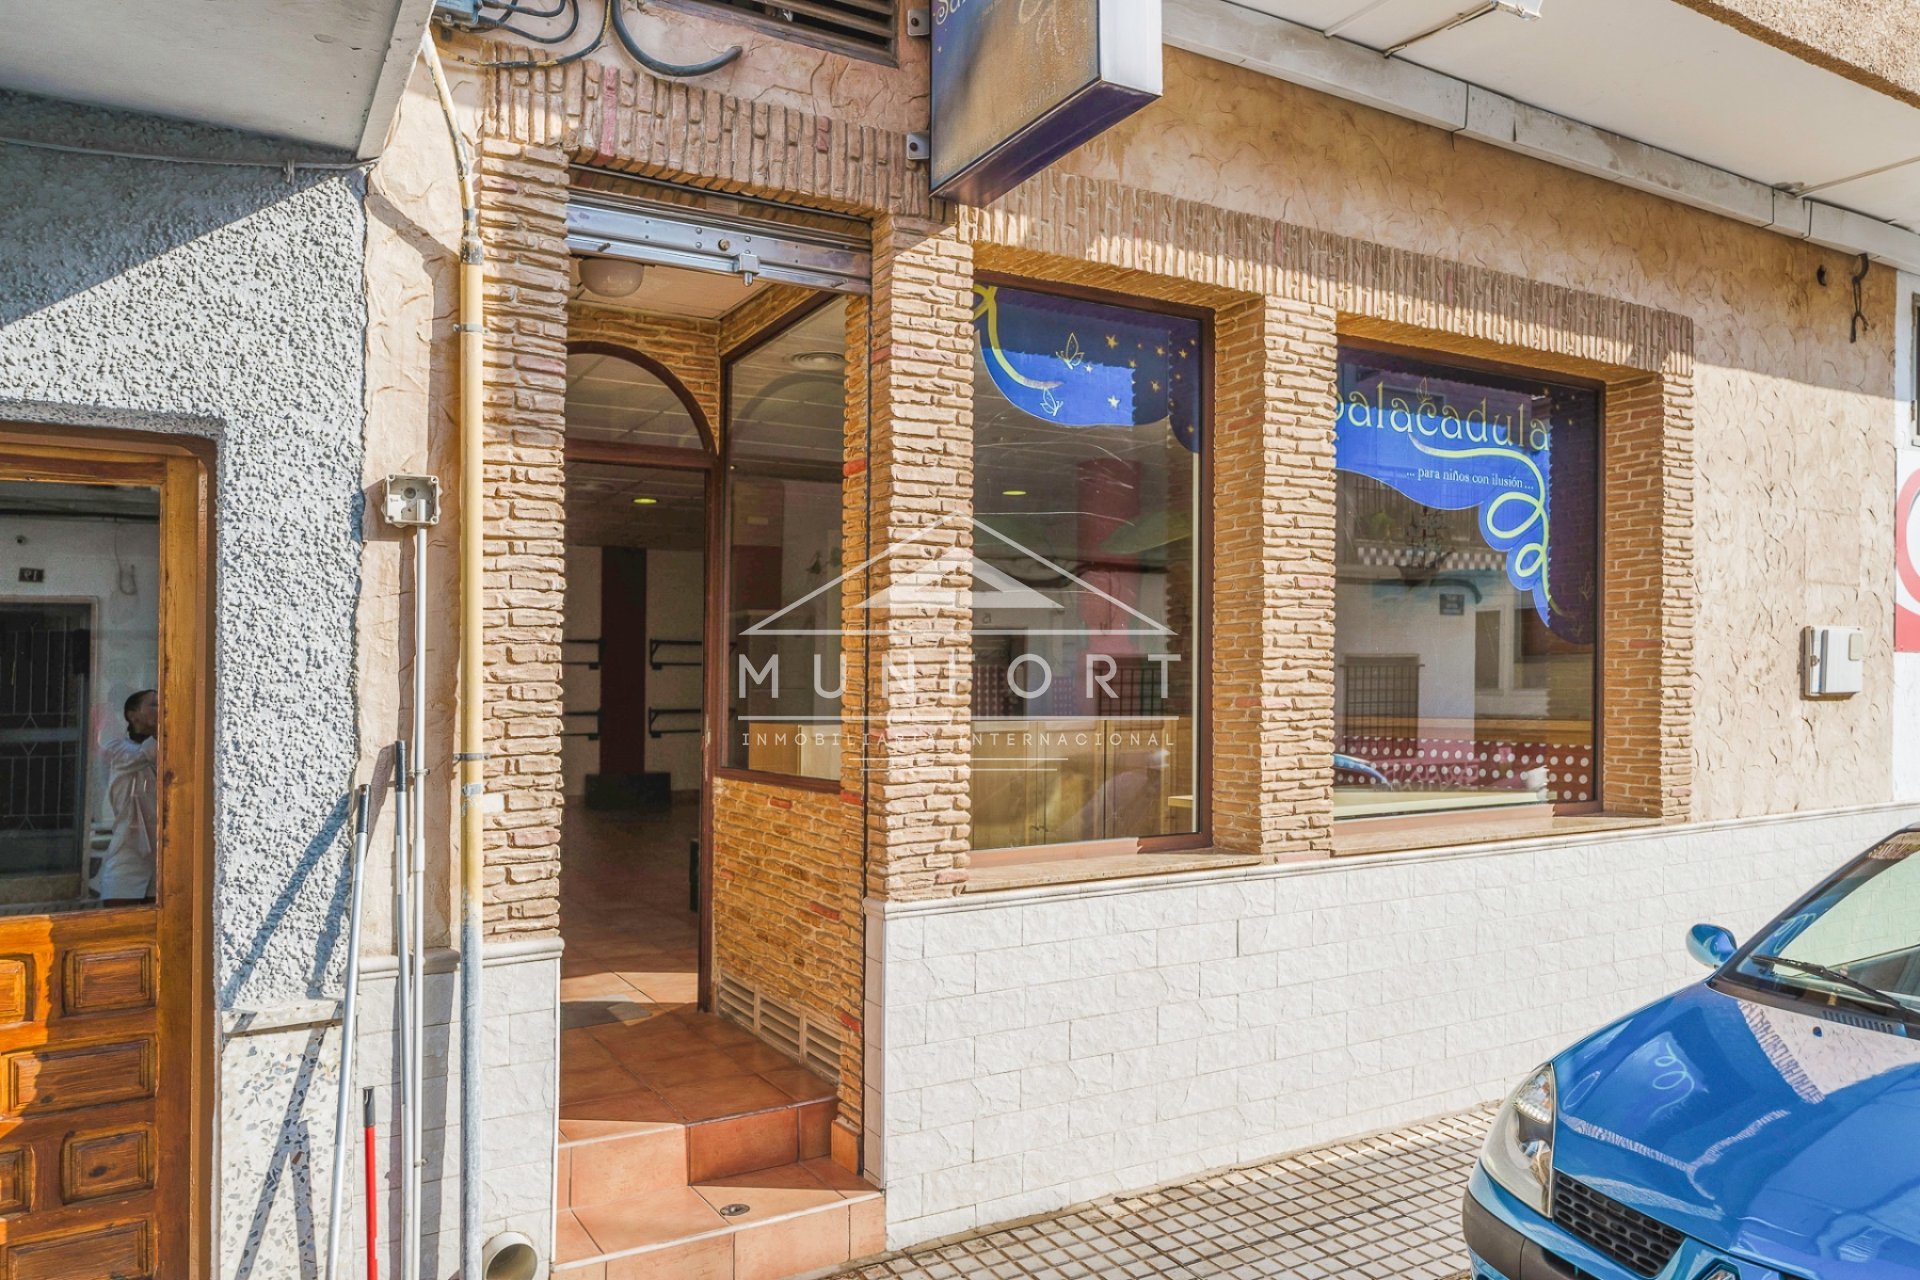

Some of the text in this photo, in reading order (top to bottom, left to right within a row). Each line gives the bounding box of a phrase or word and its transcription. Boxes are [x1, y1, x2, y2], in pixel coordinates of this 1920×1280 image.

[1418, 468, 1441, 481] para
[1443, 469, 1470, 482] niños
[1472, 475, 1489, 485] con
